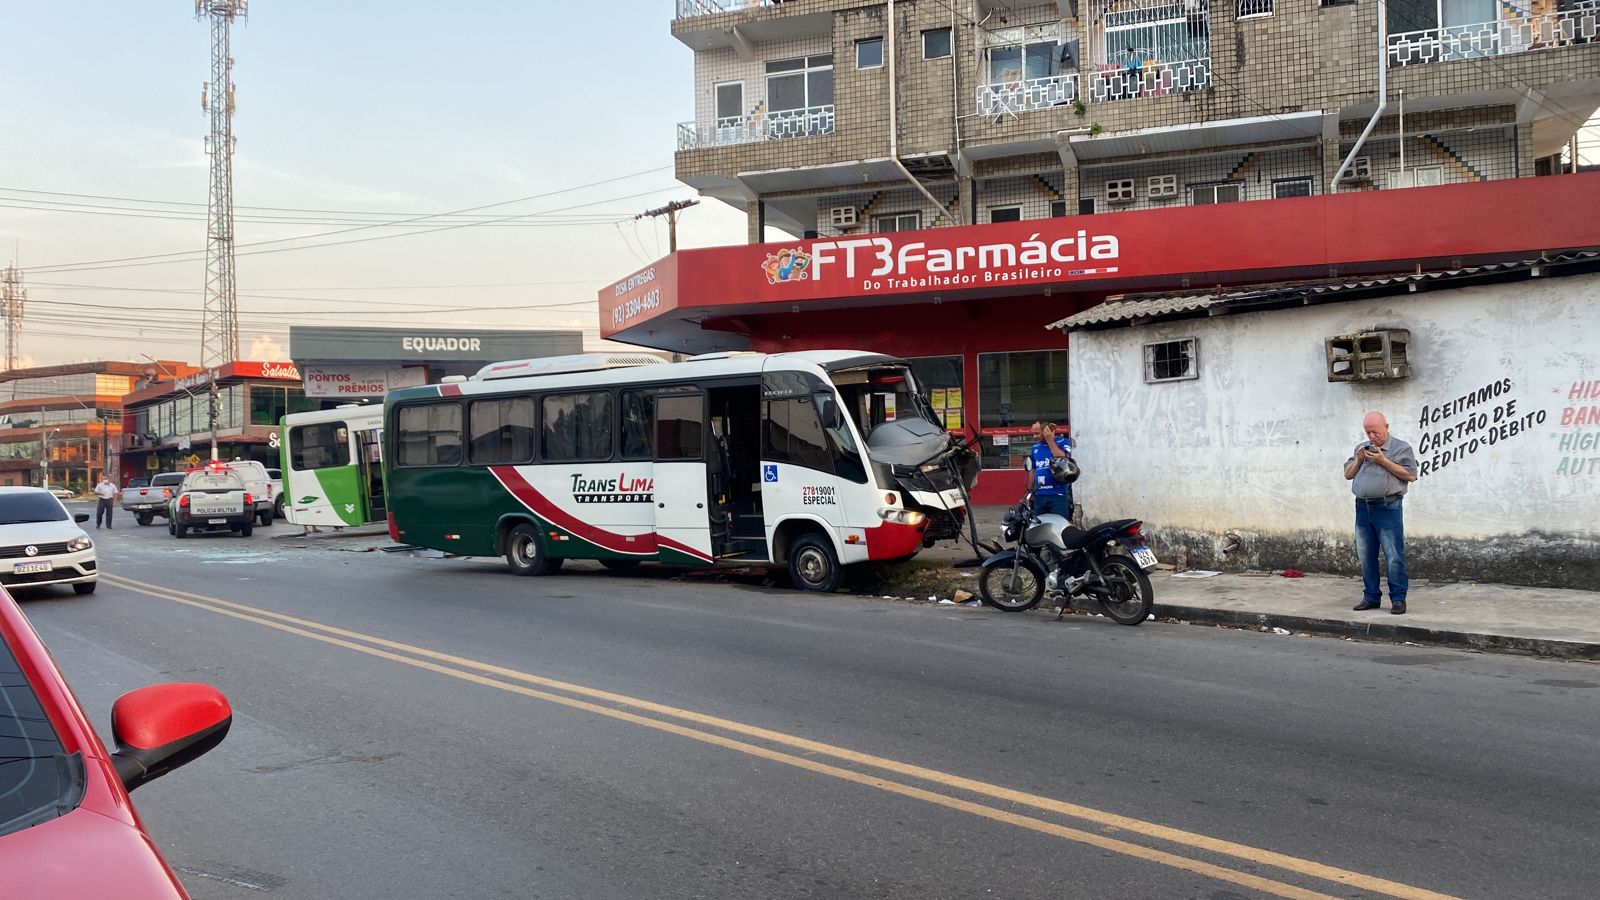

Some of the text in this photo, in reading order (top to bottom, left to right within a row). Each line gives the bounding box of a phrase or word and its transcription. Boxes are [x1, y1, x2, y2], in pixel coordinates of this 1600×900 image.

[615, 267, 656, 297] DISK ENTREGAS:
[863, 267, 1062, 290] Do Trabalhador Brasileiro
[612, 288, 660, 328] (92) 3304-4803
[402, 336, 481, 353] EQUADOR
[308, 373, 351, 382] PONTOS
[338, 382, 384, 393] PRÊMIOS
[1419, 377, 1512, 429] ACEITAMOS
[1419, 399, 1517, 455] CARTÃO DE
[1415, 438, 1479, 477] RÉDITO
[1489, 409, 1546, 446] DÉBITO
[570, 473, 617, 492] TRANS
[803, 486, 835, 496] 27819001
[803, 495, 836, 505] ESPECIAL
